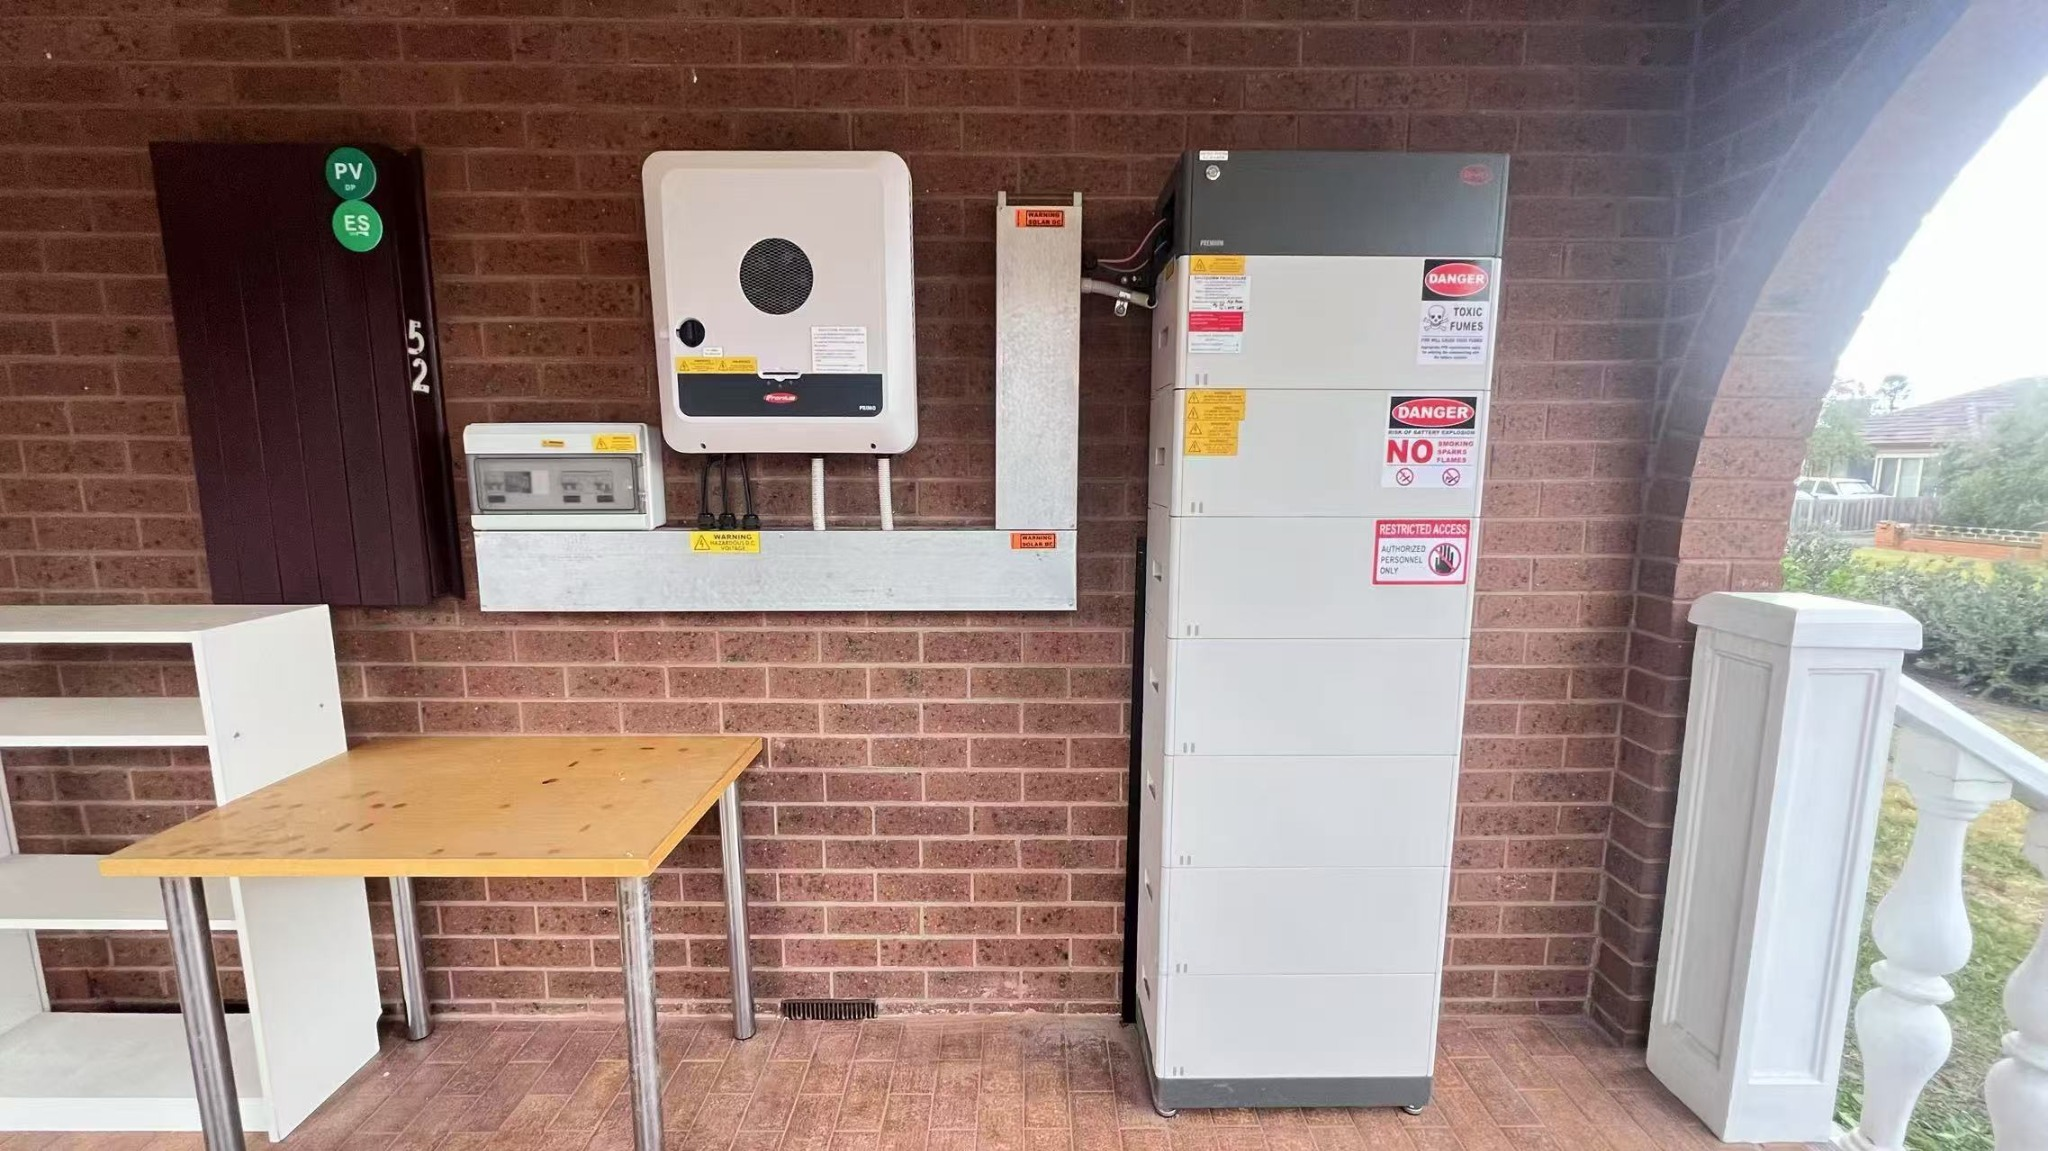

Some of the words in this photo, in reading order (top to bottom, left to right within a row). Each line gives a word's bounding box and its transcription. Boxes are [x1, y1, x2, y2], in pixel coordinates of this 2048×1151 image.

[334, 162, 363, 180] PV
[344, 215, 370, 231] ES
[1429, 273, 1485, 284] DANGER
[1453, 307, 1483, 317] TOXIC
[1449, 321, 1484, 331] FUMES
[408, 319, 430, 394] 52
[1397, 406, 1469, 419] DANGER
[1386, 439, 1433, 463] NO
[1379, 523, 1431, 535] RESTRICTED
[1432, 523, 1467, 535] ACCESS
[1381, 545, 1426, 553] AUTHORIZED
[1380, 556, 1423, 564] PERSONNEL
[1380, 567, 1399, 575] ONLY
